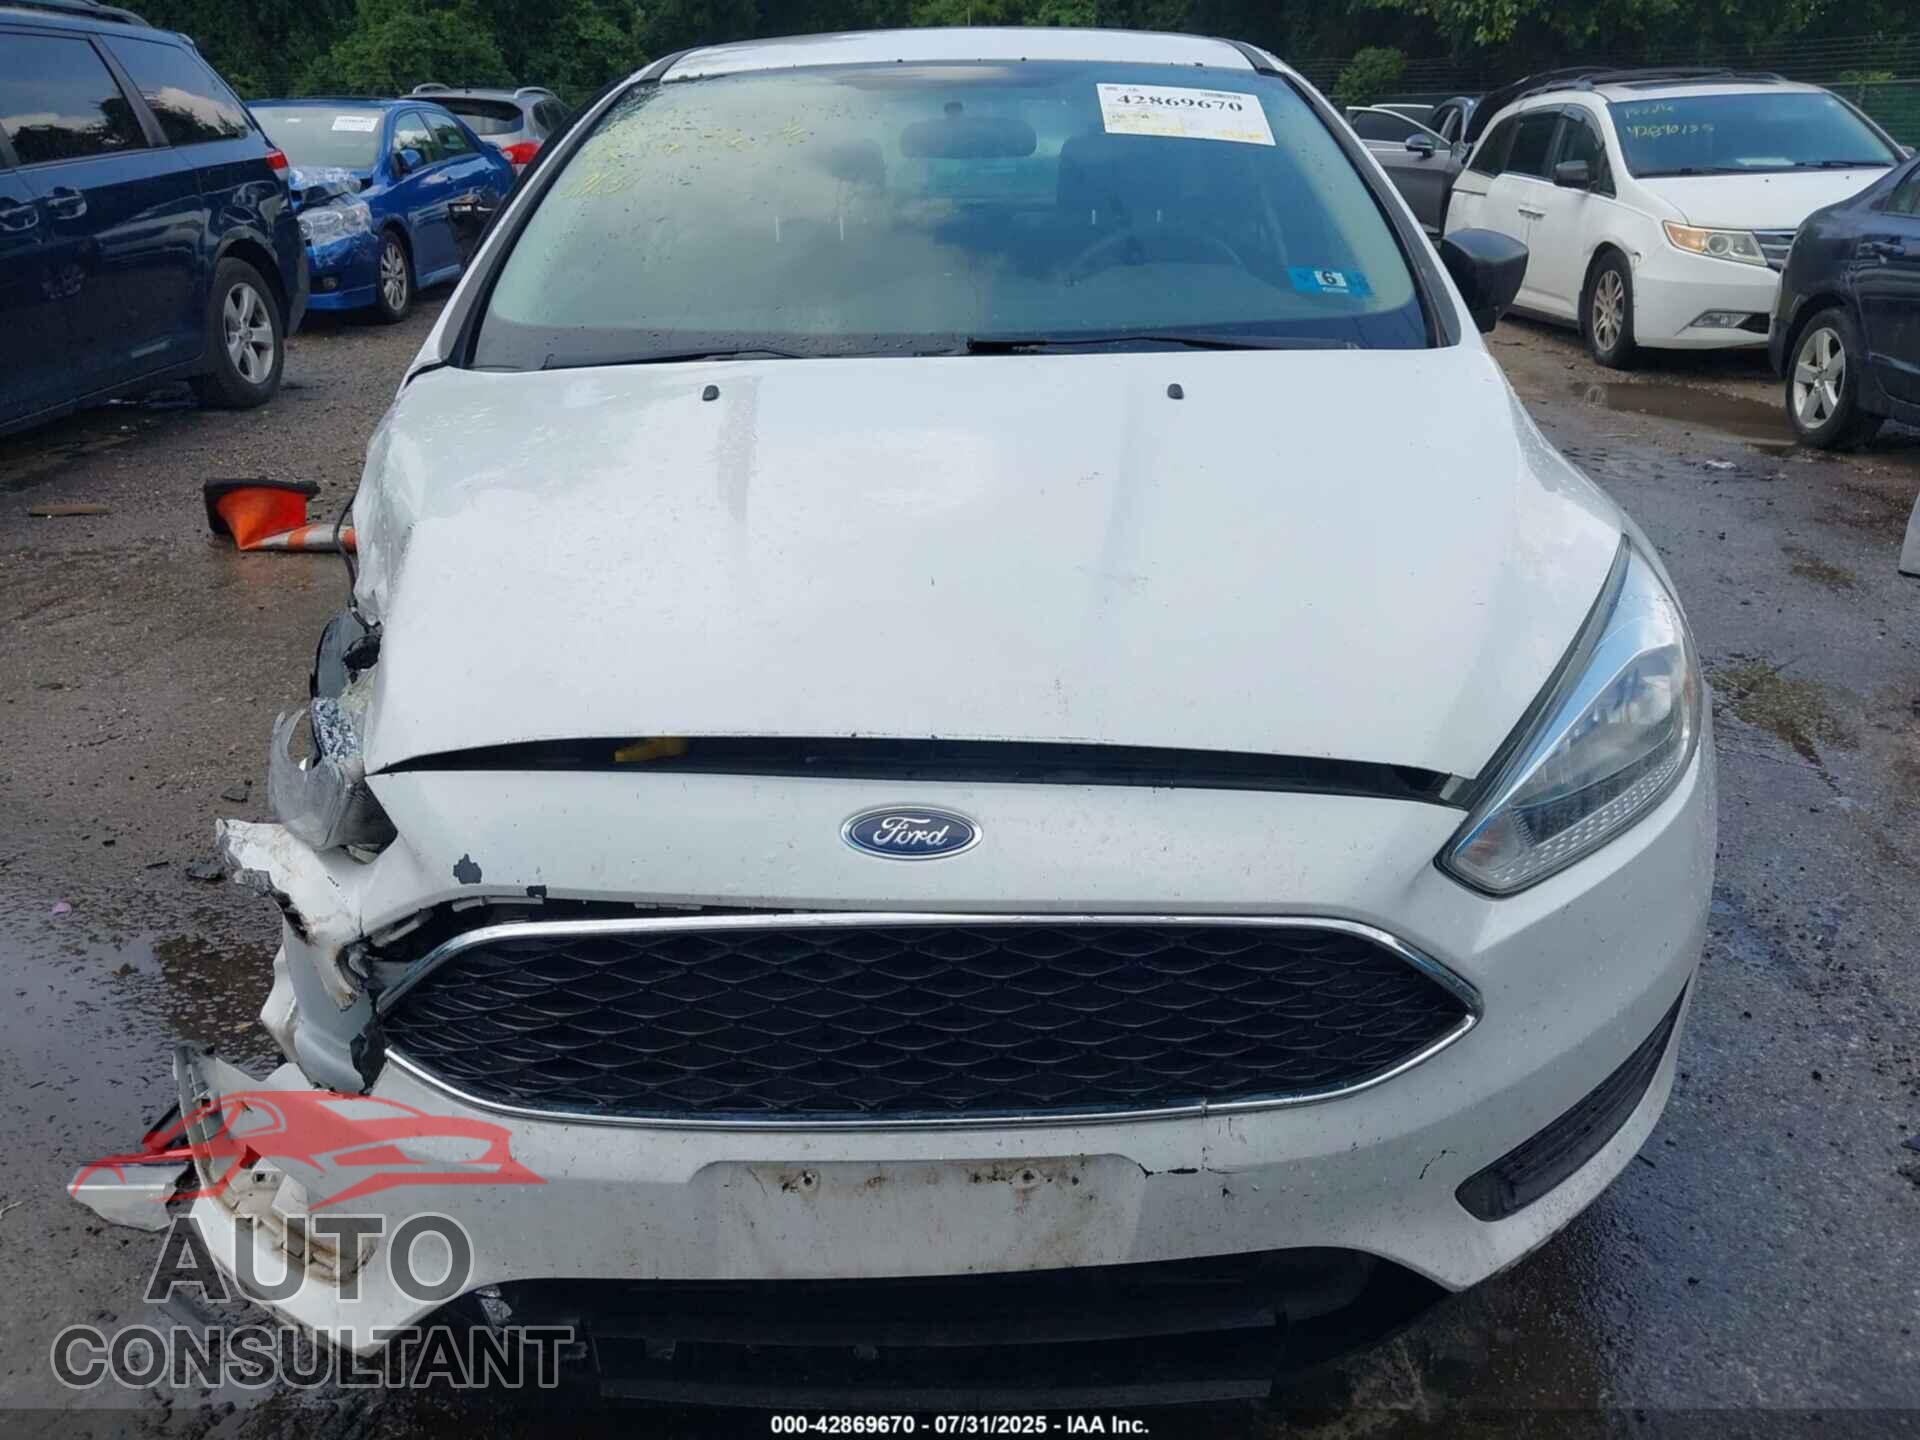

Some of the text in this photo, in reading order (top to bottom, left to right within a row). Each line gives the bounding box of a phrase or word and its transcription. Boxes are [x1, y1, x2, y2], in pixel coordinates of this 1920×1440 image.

[1117, 94, 1243, 112] 42869670
[1321, 271, 1337, 285] 6
[872, 816, 950, 846] Ford
